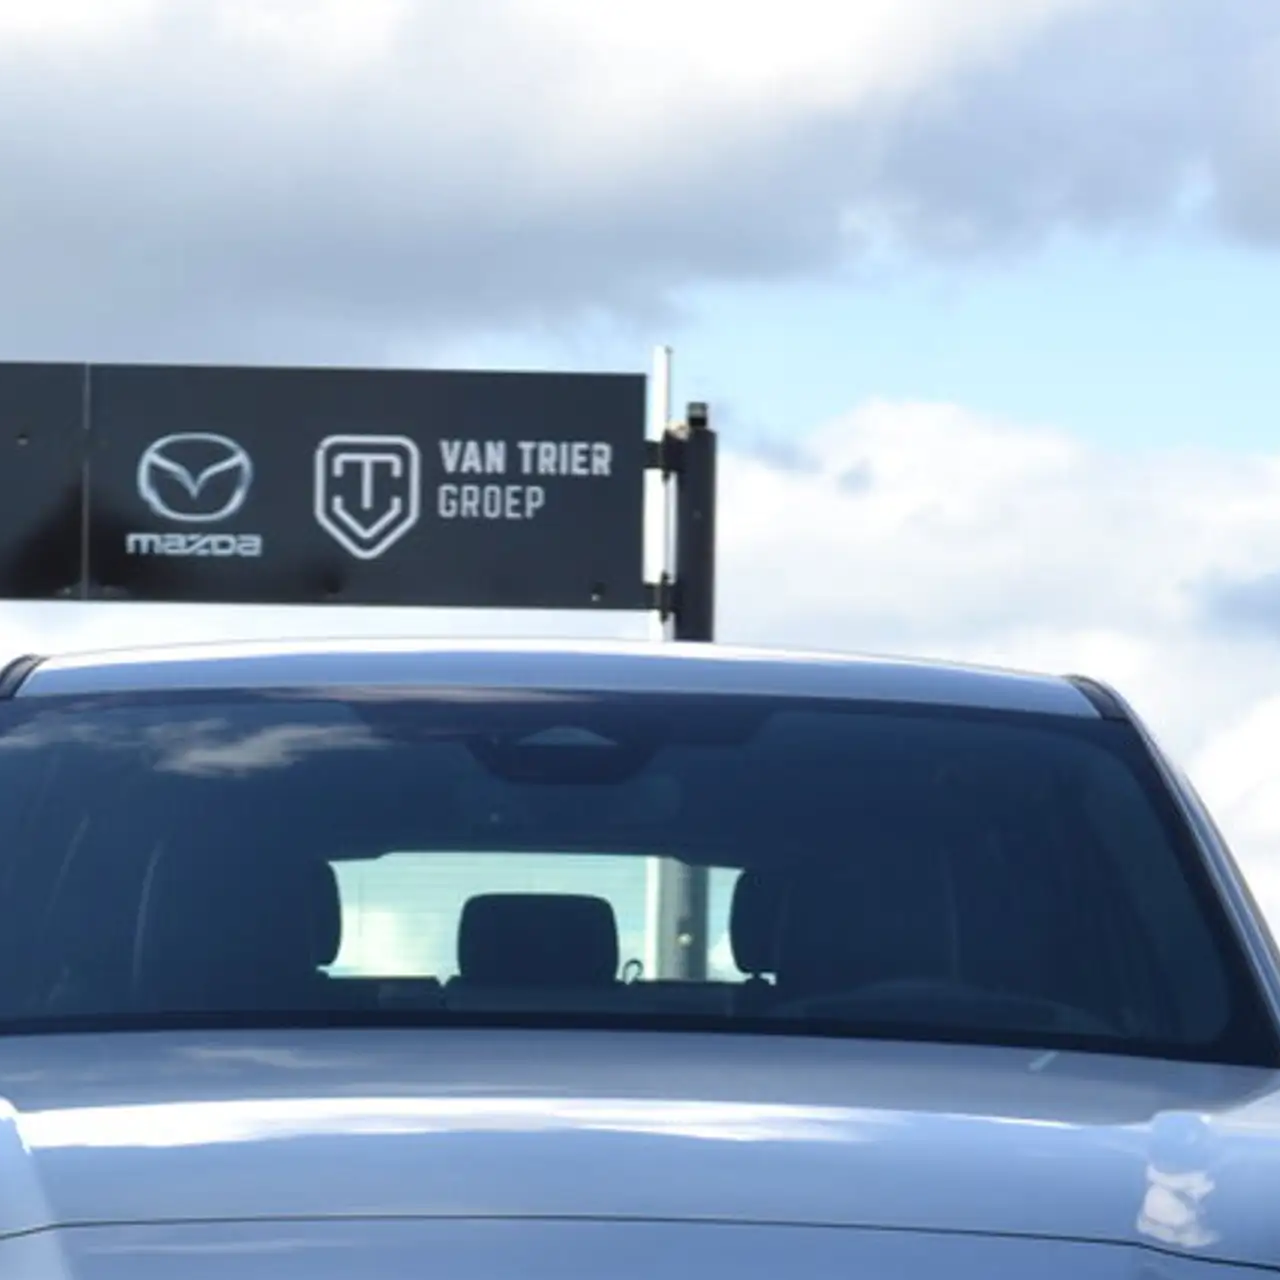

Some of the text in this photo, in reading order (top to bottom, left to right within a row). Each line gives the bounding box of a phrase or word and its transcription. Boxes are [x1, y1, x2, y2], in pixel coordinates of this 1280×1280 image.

[439, 439, 613, 477] VAN TRIER
[437, 484, 545, 520] GROEP
